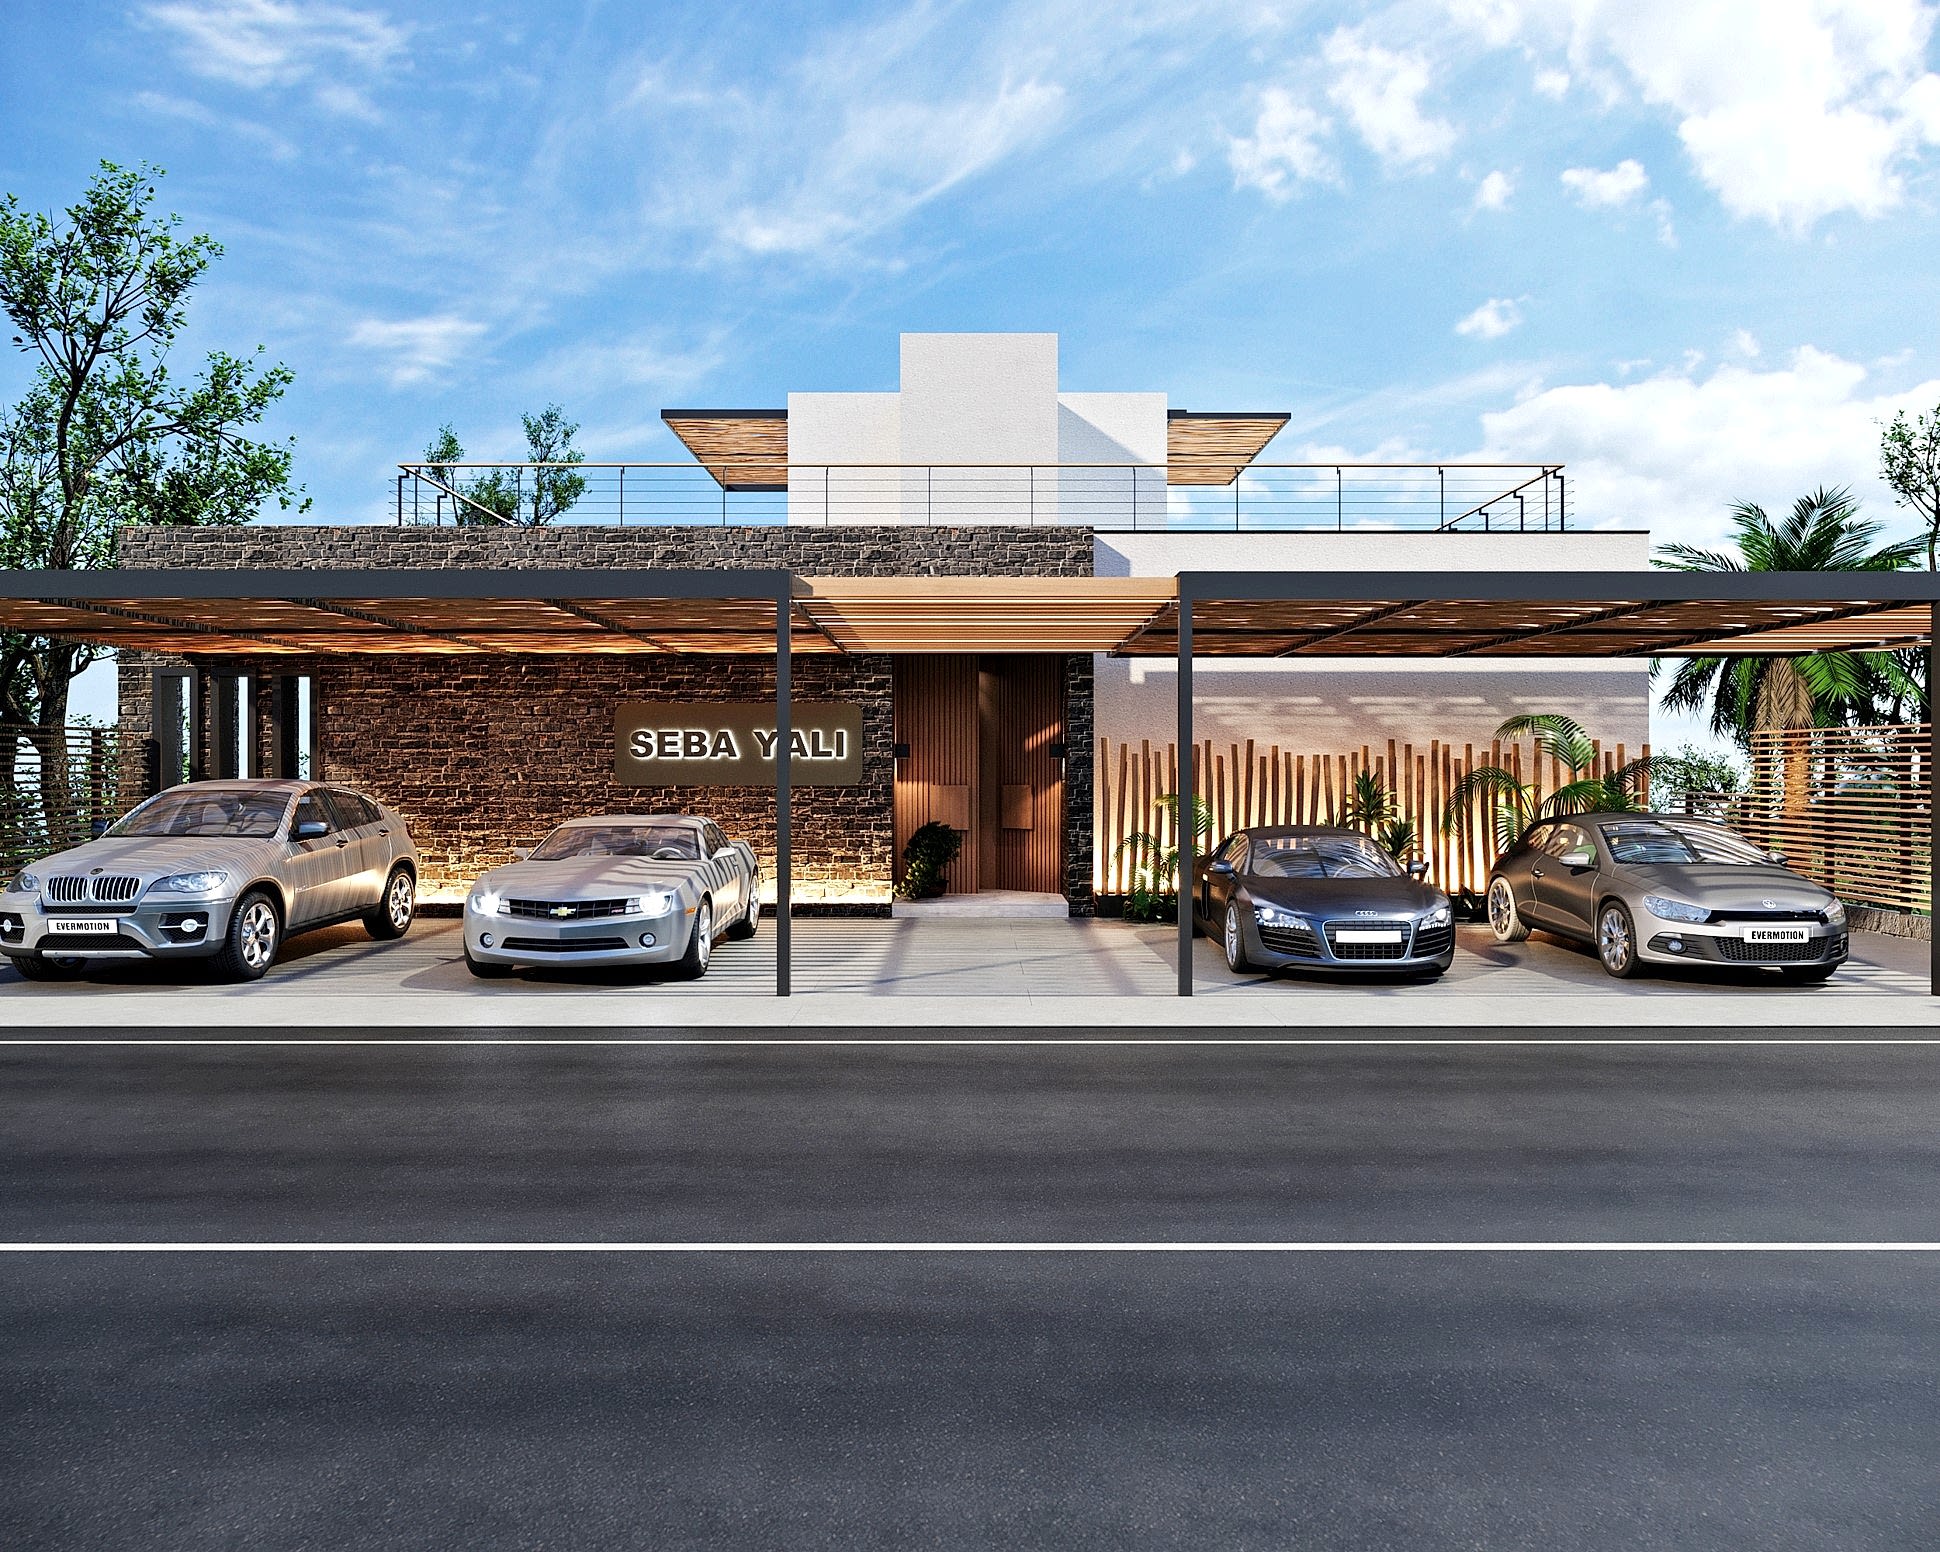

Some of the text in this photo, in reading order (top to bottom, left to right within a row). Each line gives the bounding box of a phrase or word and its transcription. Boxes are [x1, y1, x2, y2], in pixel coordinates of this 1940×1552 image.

[629, 729, 847, 760] SEBA YALI
[56, 922, 110, 931] EVERMOTION
[1751, 930, 1804, 940] EVERMOTION
